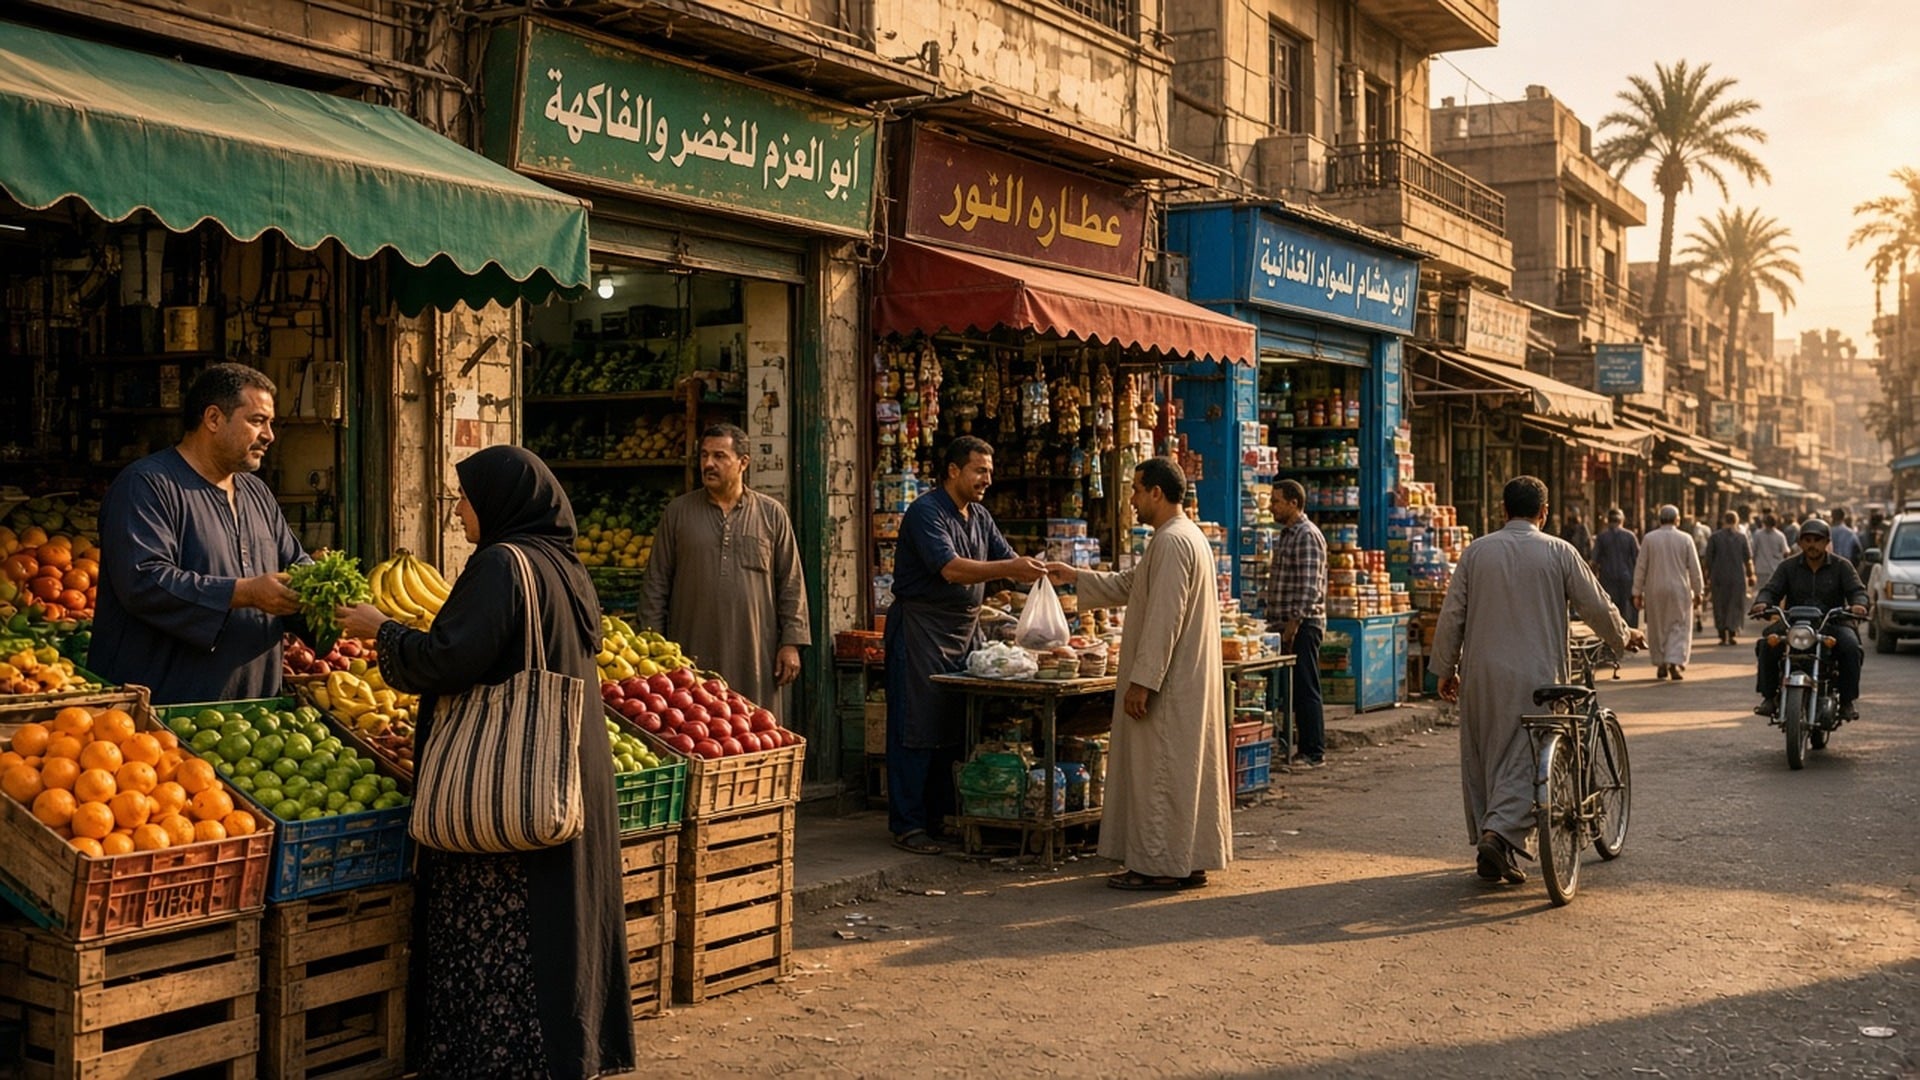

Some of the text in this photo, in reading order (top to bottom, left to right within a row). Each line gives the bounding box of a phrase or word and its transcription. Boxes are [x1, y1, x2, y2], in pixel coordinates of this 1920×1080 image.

[544, 67, 860, 201] أبو العزم للخضر والفاكهة
[1260, 237, 1317, 287] الغذائية
[1317, 256, 1356, 300] للمواد
[1356, 266, 1391, 310] هشام
